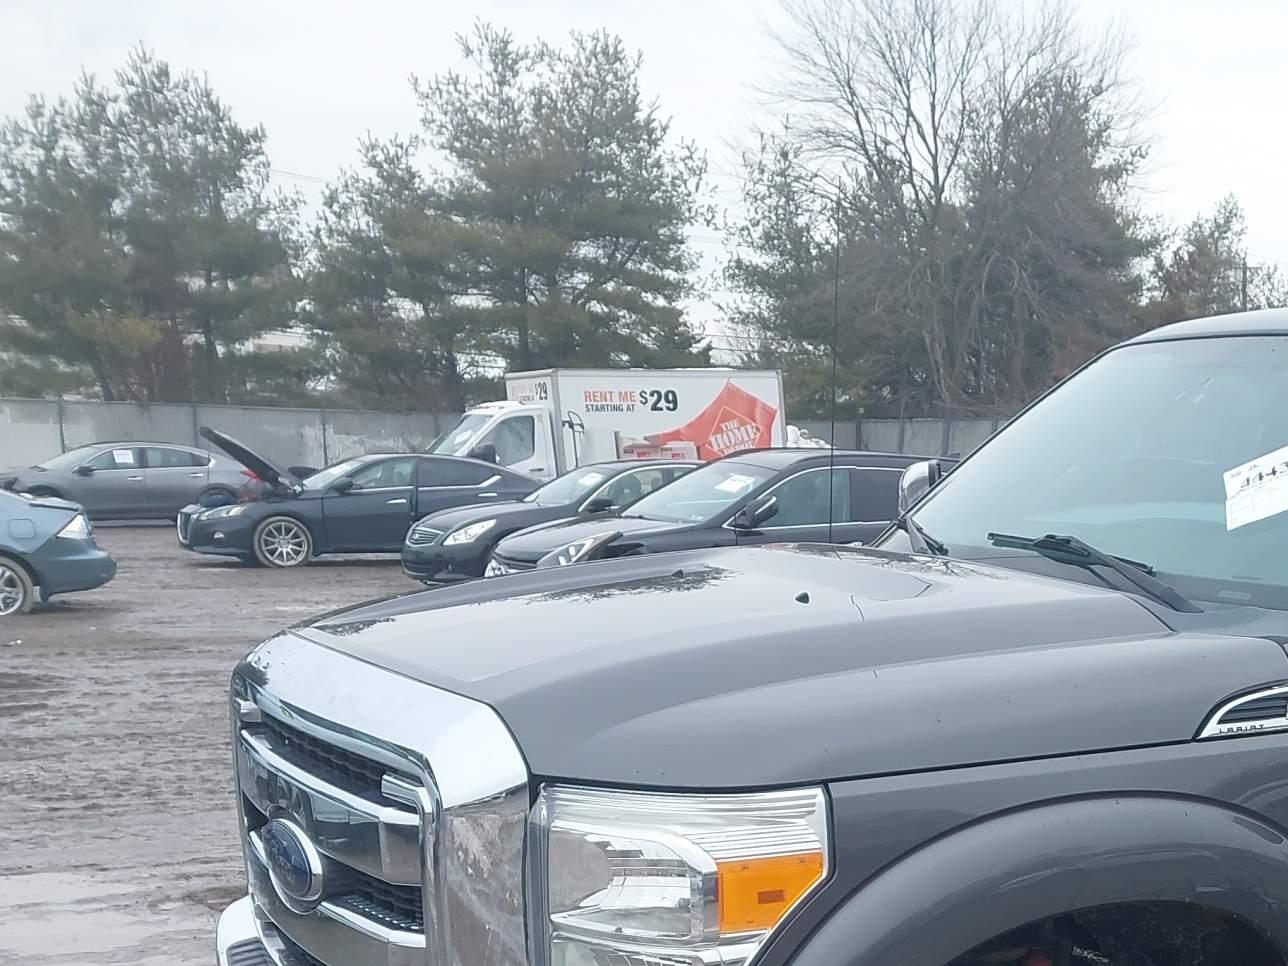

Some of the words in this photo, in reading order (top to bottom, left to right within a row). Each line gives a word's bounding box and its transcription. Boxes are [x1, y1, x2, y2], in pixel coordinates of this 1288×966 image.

[584, 391, 614, 402] RENT
[618, 391, 636, 402] ME
[639, 390, 678, 411] $29
[585, 404, 623, 412] STARTING
[626, 404, 635, 412] AT
[720, 418, 739, 431] THE
[710, 424, 759, 452] HOME
[1219, 724, 1265, 734] LARIAT
